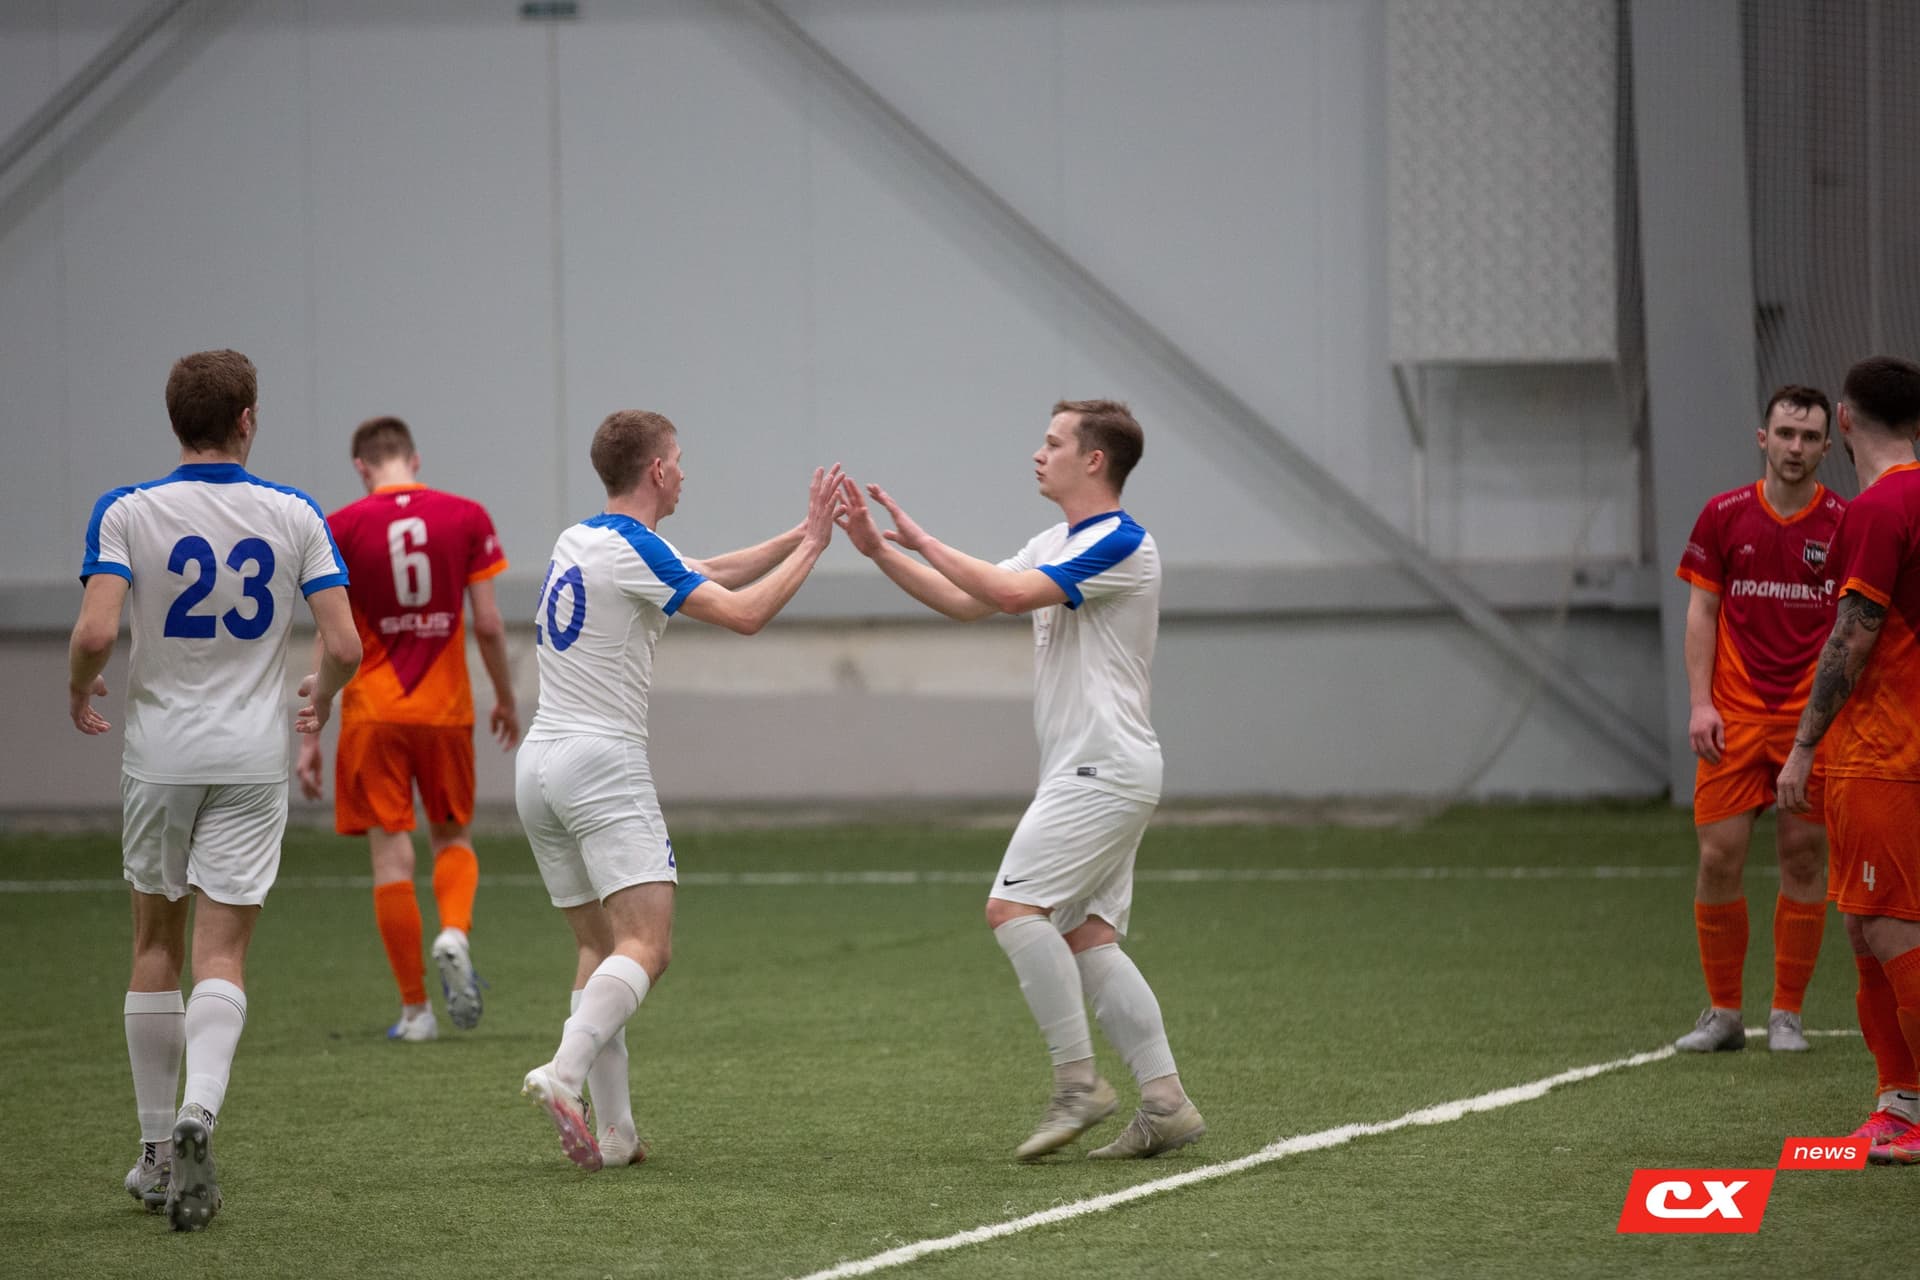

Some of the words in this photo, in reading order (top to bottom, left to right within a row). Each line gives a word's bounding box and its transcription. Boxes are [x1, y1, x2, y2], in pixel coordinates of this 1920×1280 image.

[163, 535, 276, 640] 23
[387, 516, 432, 608] 6
[1863, 861, 1876, 892] 4
[144, 1142, 157, 1167] IKE
